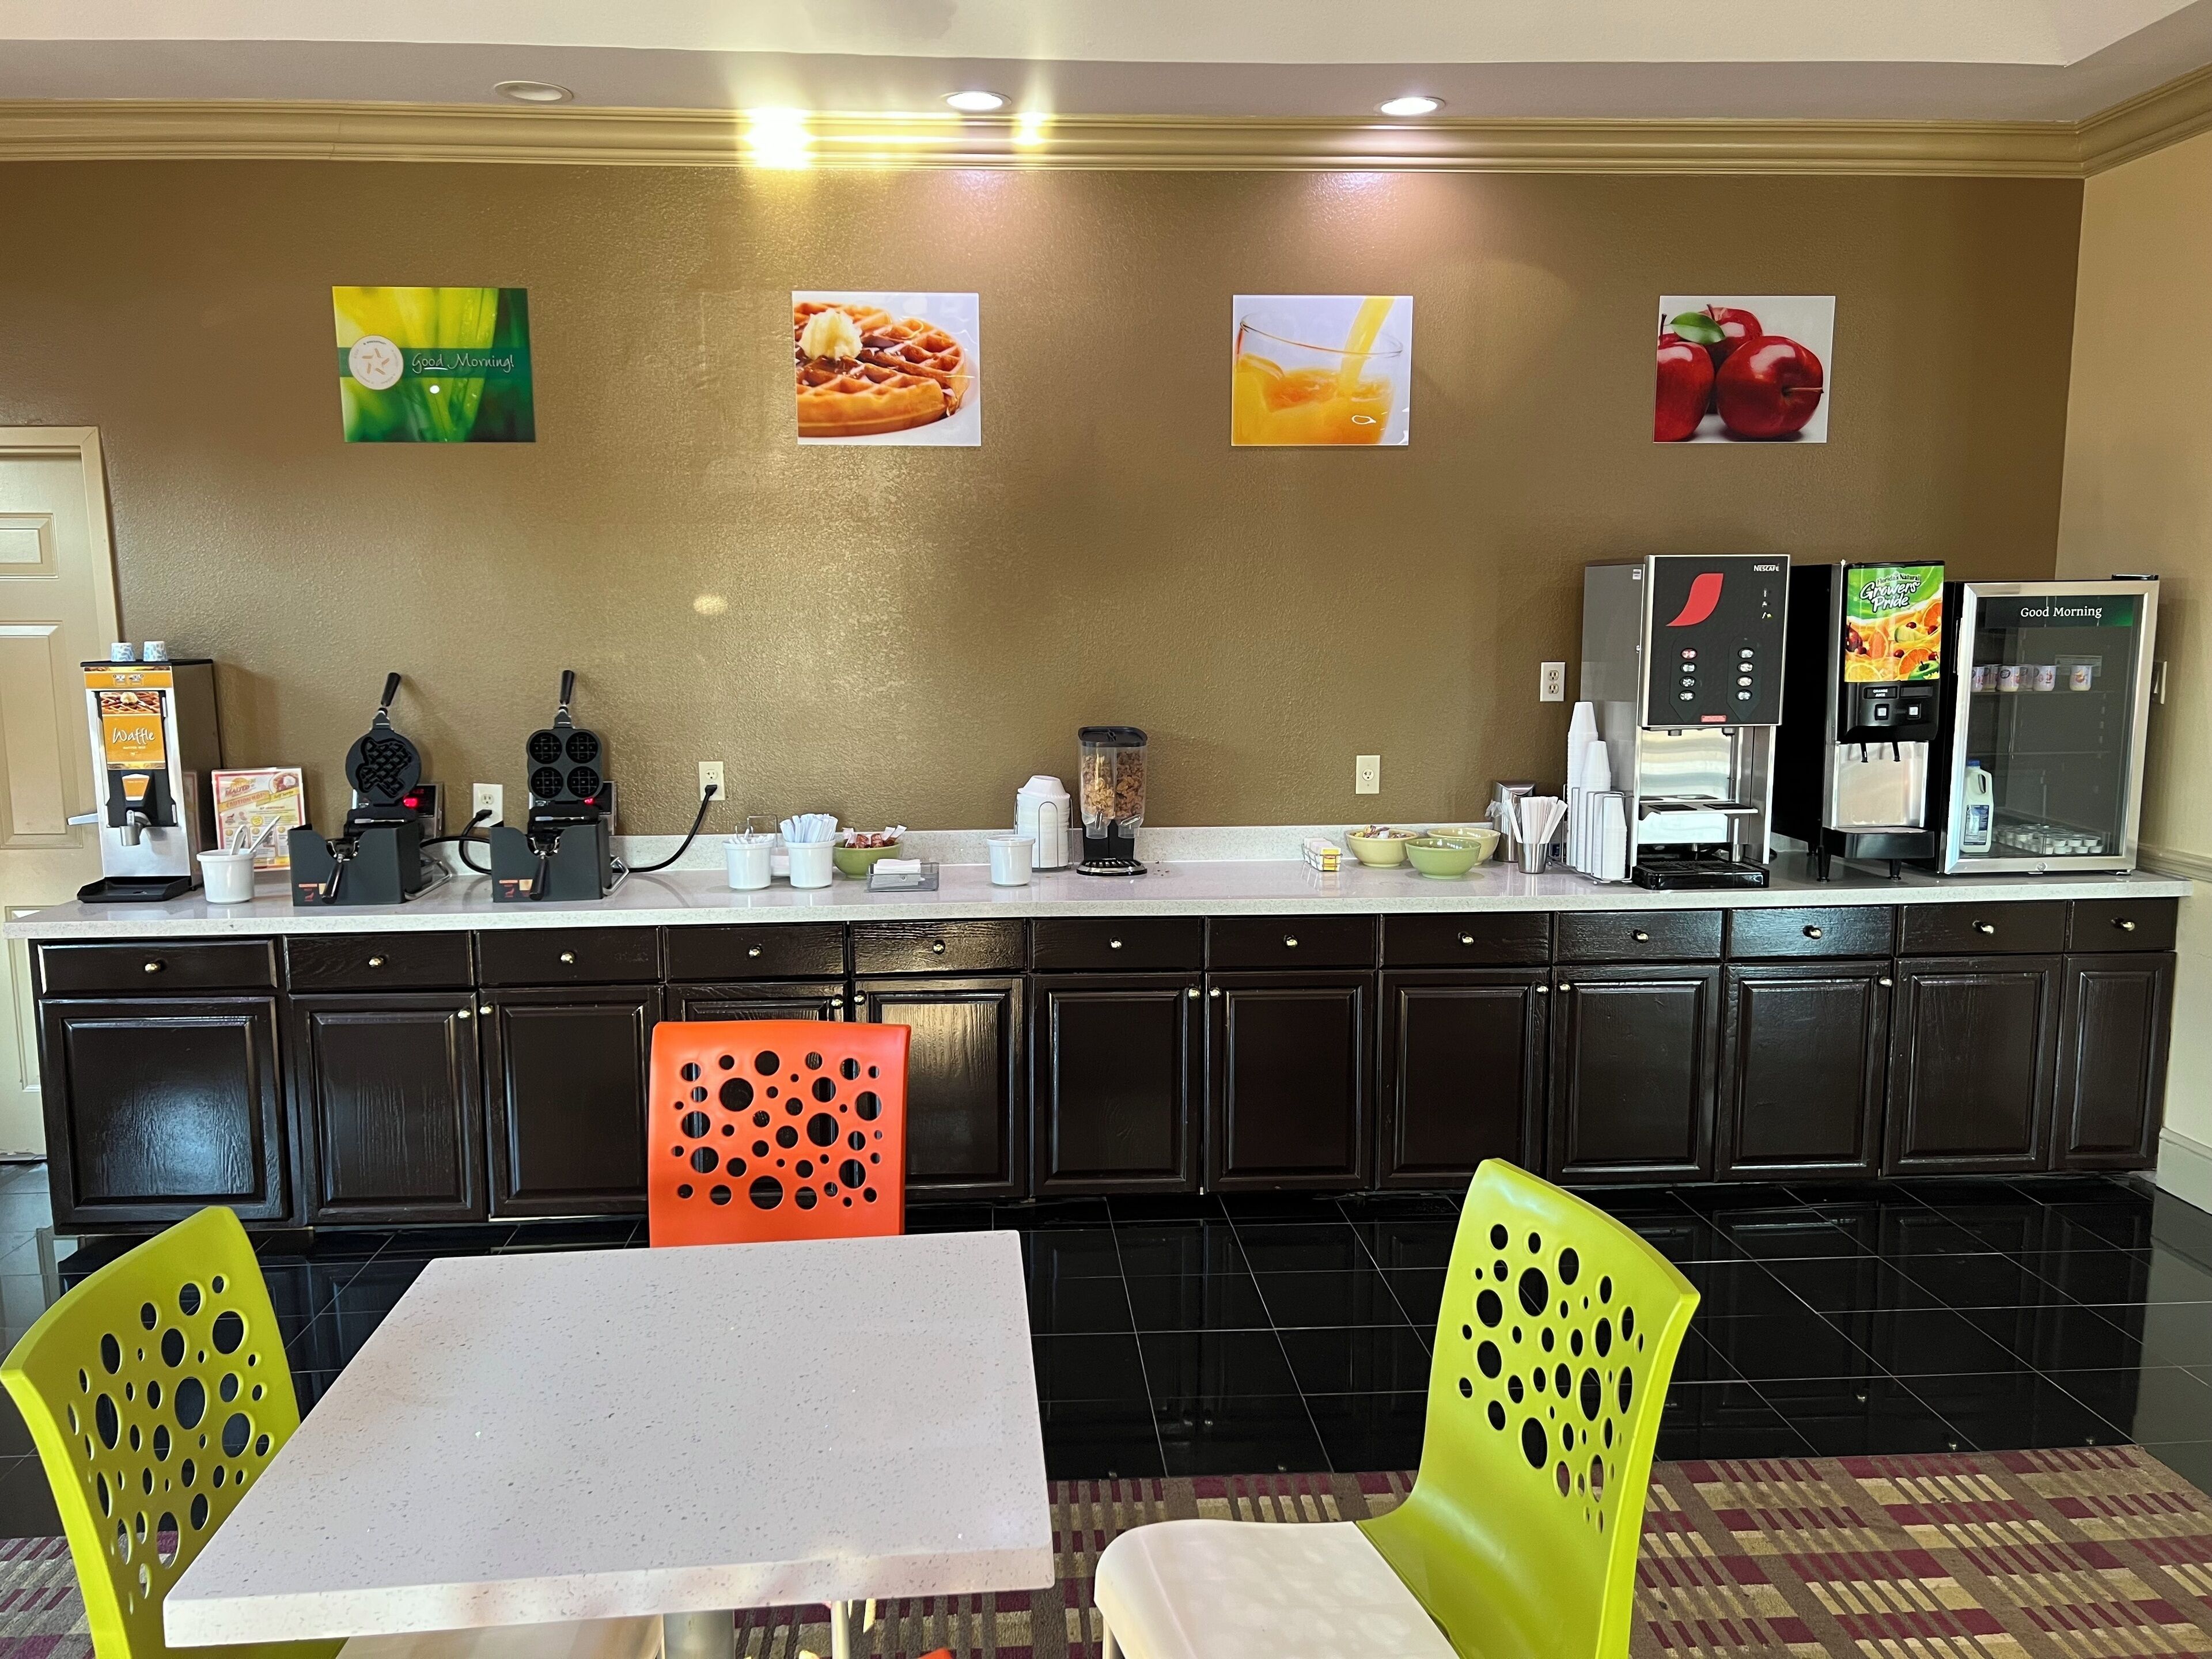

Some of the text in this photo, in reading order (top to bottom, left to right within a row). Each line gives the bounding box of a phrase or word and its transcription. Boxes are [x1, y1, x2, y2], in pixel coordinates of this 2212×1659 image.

[412, 353, 444, 374] Good
[447, 353, 514, 373] Morning!
[1877, 573, 1921, 585] Florida's Natural
[1870, 593, 1910, 613] Pride
[2020, 605, 2103, 619] Good Morning
[112, 727, 156, 745] Waffle
[226, 796, 252, 808] CAUTION
